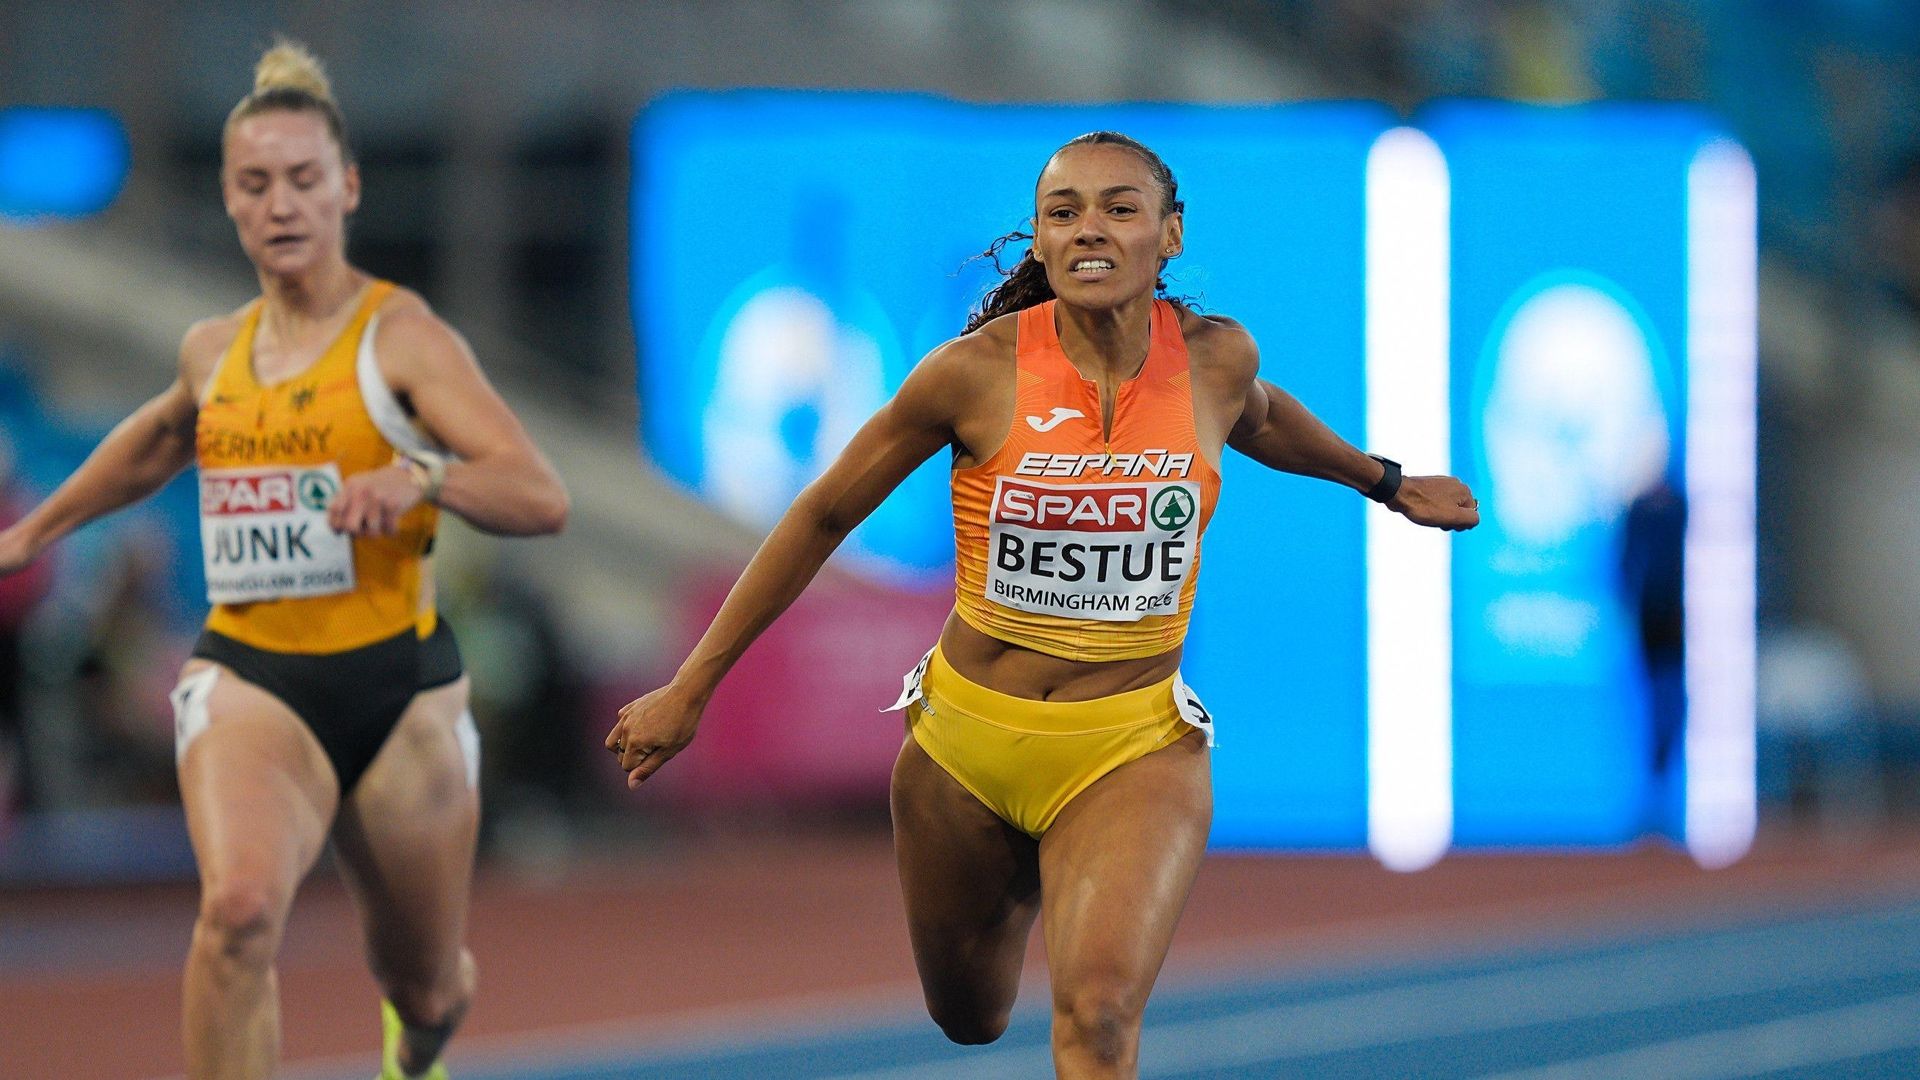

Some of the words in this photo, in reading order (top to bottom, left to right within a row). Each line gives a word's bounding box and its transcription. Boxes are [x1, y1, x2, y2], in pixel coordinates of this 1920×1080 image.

[1015, 449, 1195, 478] ESPAÑA
[1001, 489, 1142, 526] SPAR
[213, 523, 312, 563] JUNK
[997, 531, 1186, 583] BESTUÉ
[994, 579, 1129, 611] BIRMINGHAM
